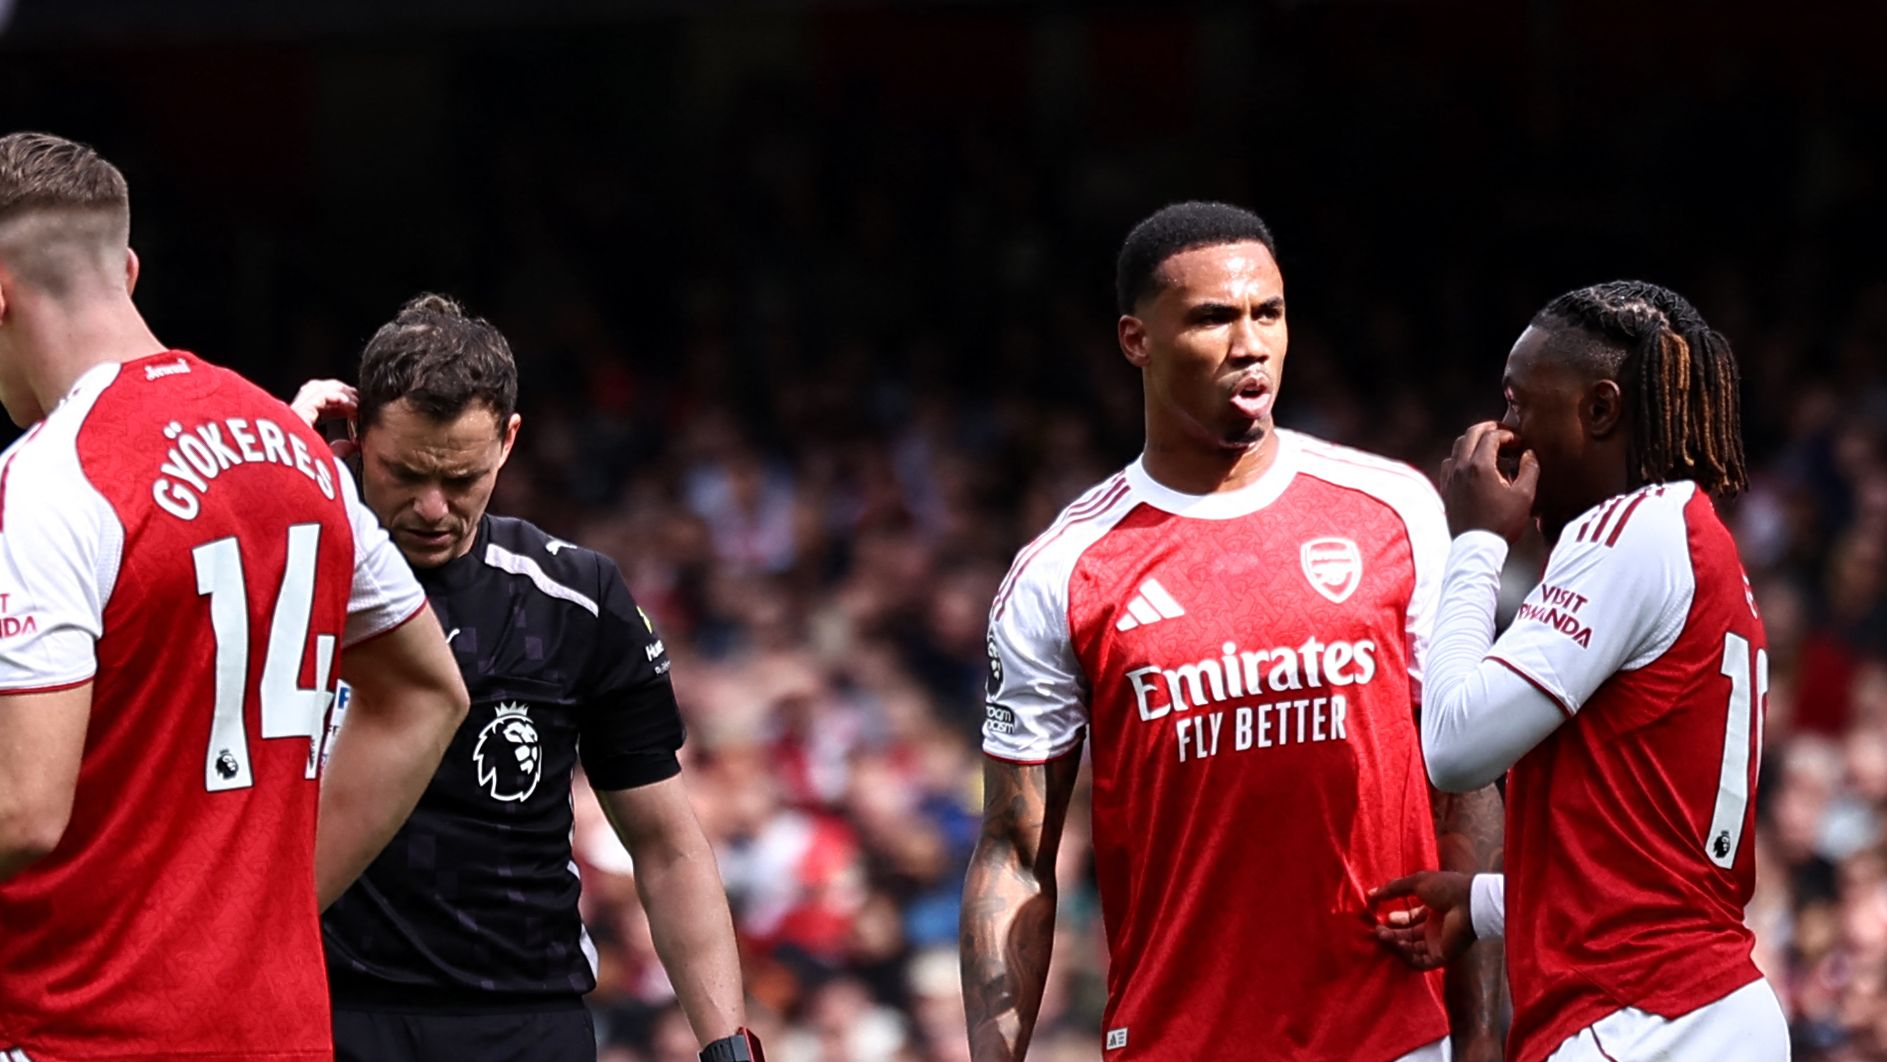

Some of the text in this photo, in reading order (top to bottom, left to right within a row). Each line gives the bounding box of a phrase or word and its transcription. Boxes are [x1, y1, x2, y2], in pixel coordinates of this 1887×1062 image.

[152, 417, 335, 520] GYÖKERES
[1542, 583, 1588, 613] VISIT
[192, 523, 335, 792] 14
[1125, 634, 1376, 722] Emirates
[1175, 693, 1347, 763] FLY BETTER
